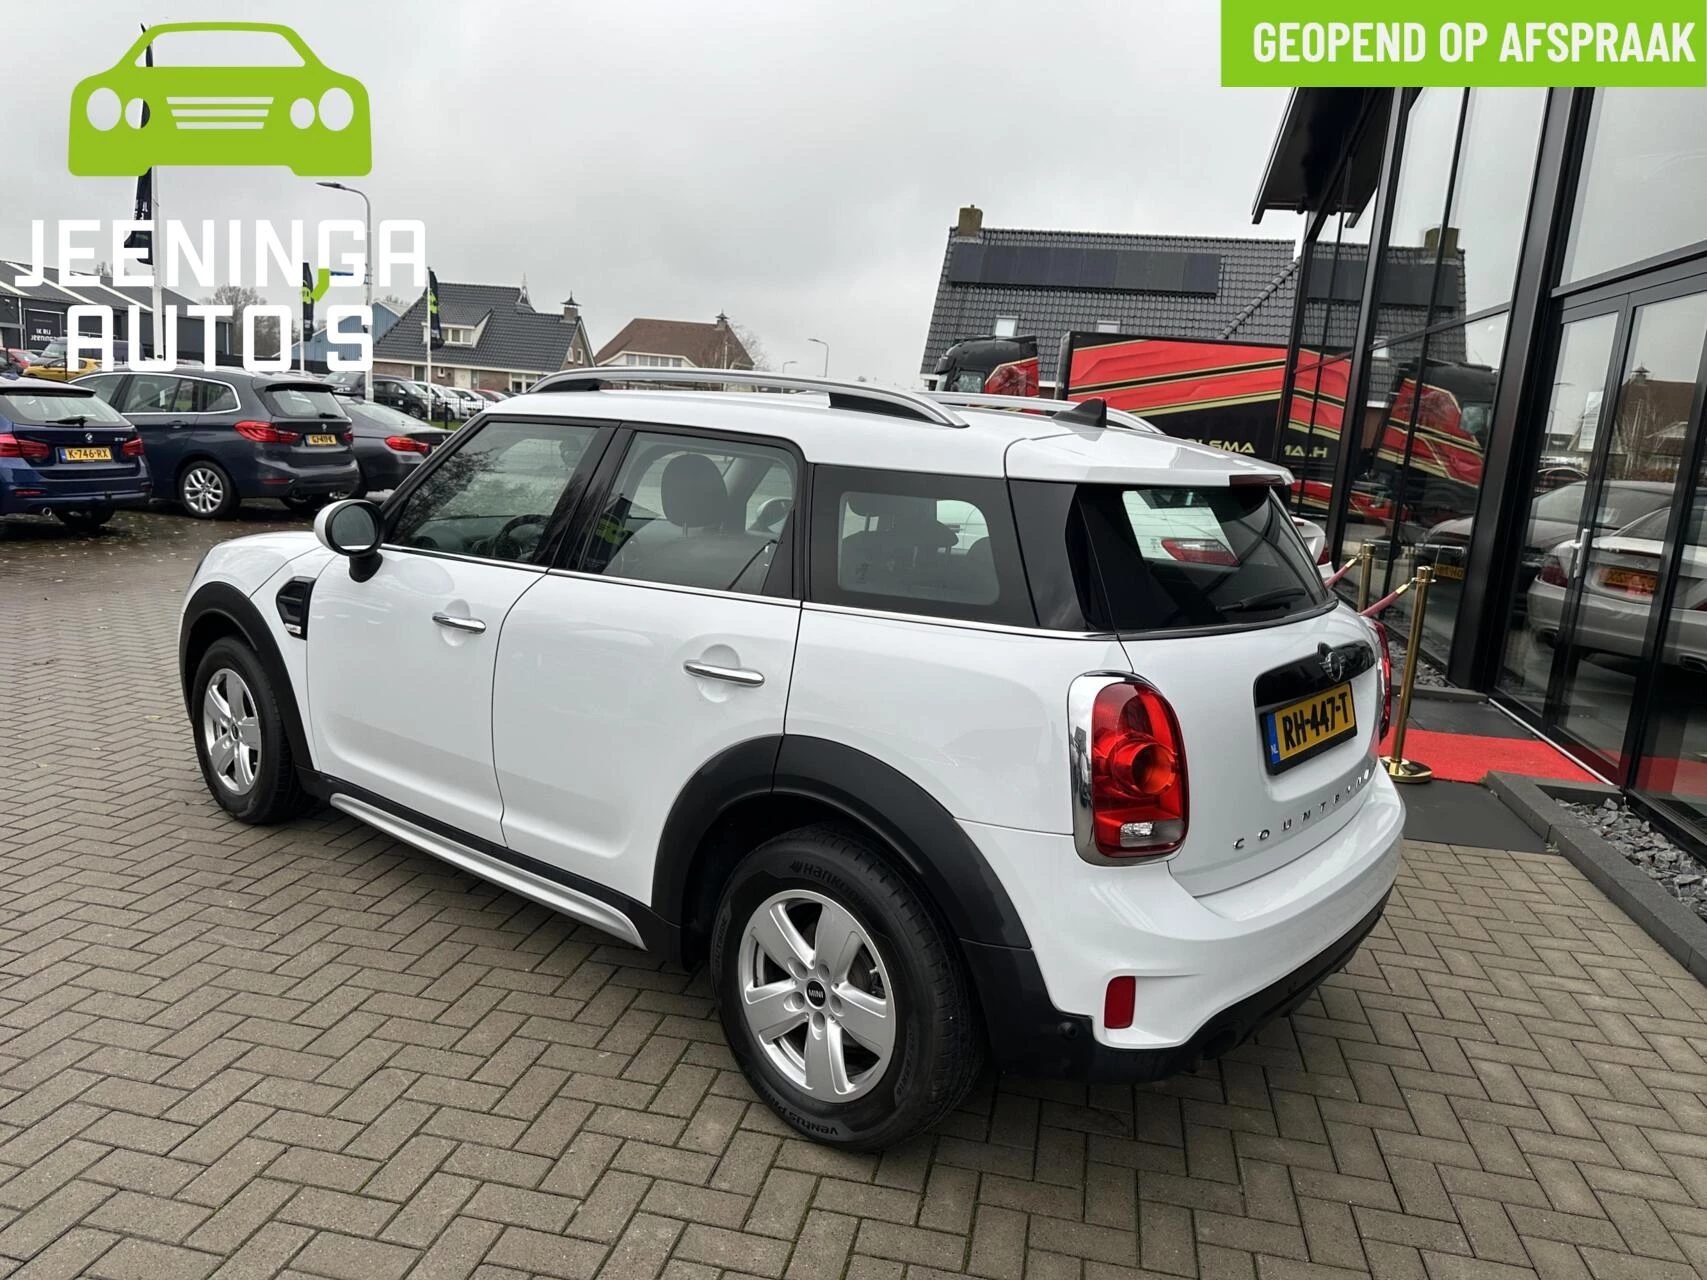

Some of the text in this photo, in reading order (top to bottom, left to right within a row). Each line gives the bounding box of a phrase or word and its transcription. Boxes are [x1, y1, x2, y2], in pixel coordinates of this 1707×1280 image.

[68, 447, 108, 459] K-746-RX
[1282, 692, 1349, 752] RH-447-T
[808, 988, 824, 999] MINI
